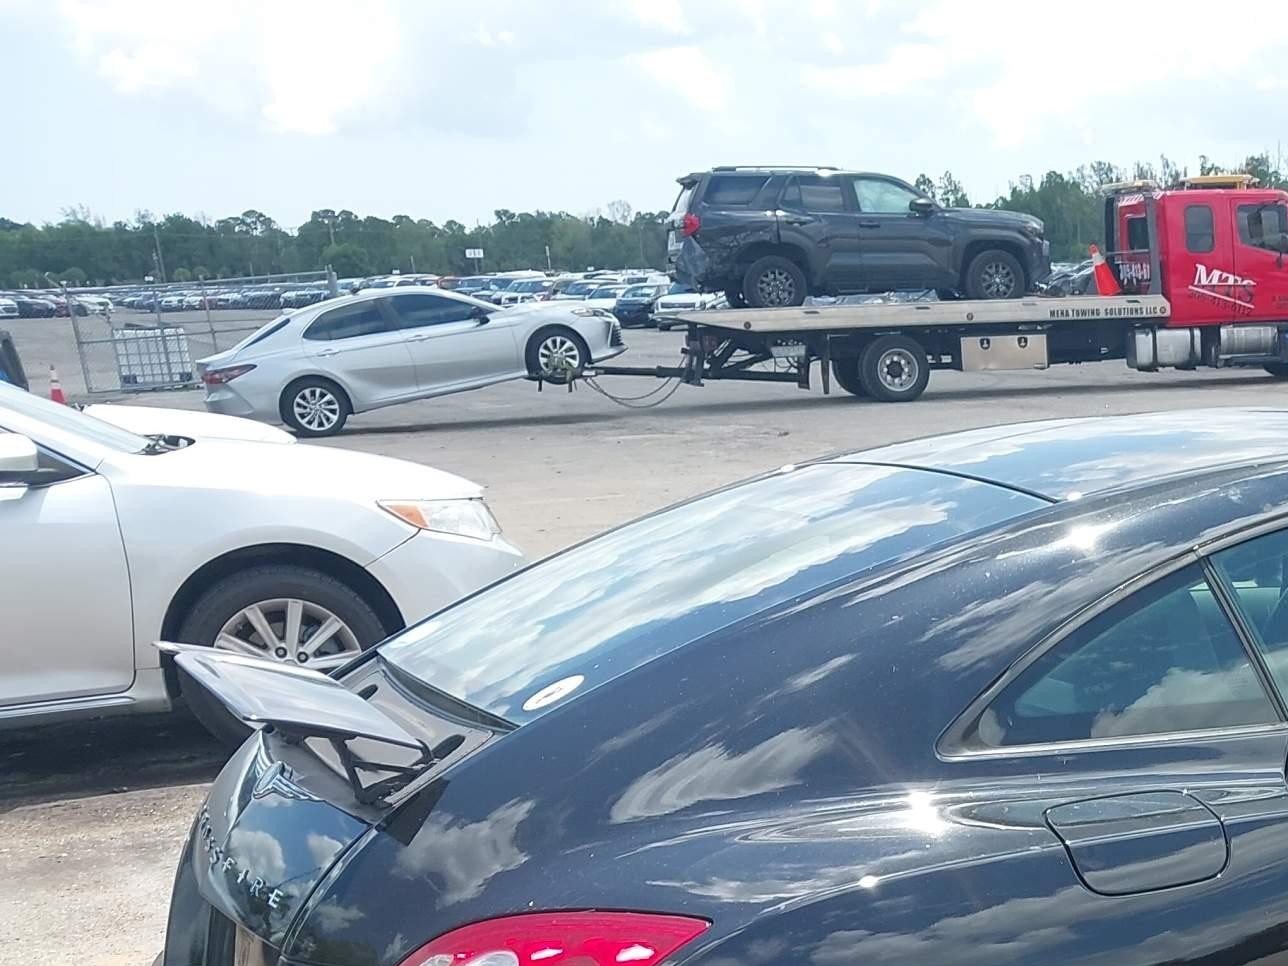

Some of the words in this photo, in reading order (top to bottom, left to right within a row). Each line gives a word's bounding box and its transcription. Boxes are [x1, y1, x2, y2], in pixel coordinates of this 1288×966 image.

[1191, 263, 1256, 303] MTS
[1071, 308, 1101, 318] TOWING
[1103, 306, 1144, 317] SOLUTIONS
[1145, 306, 1158, 315] LLC
